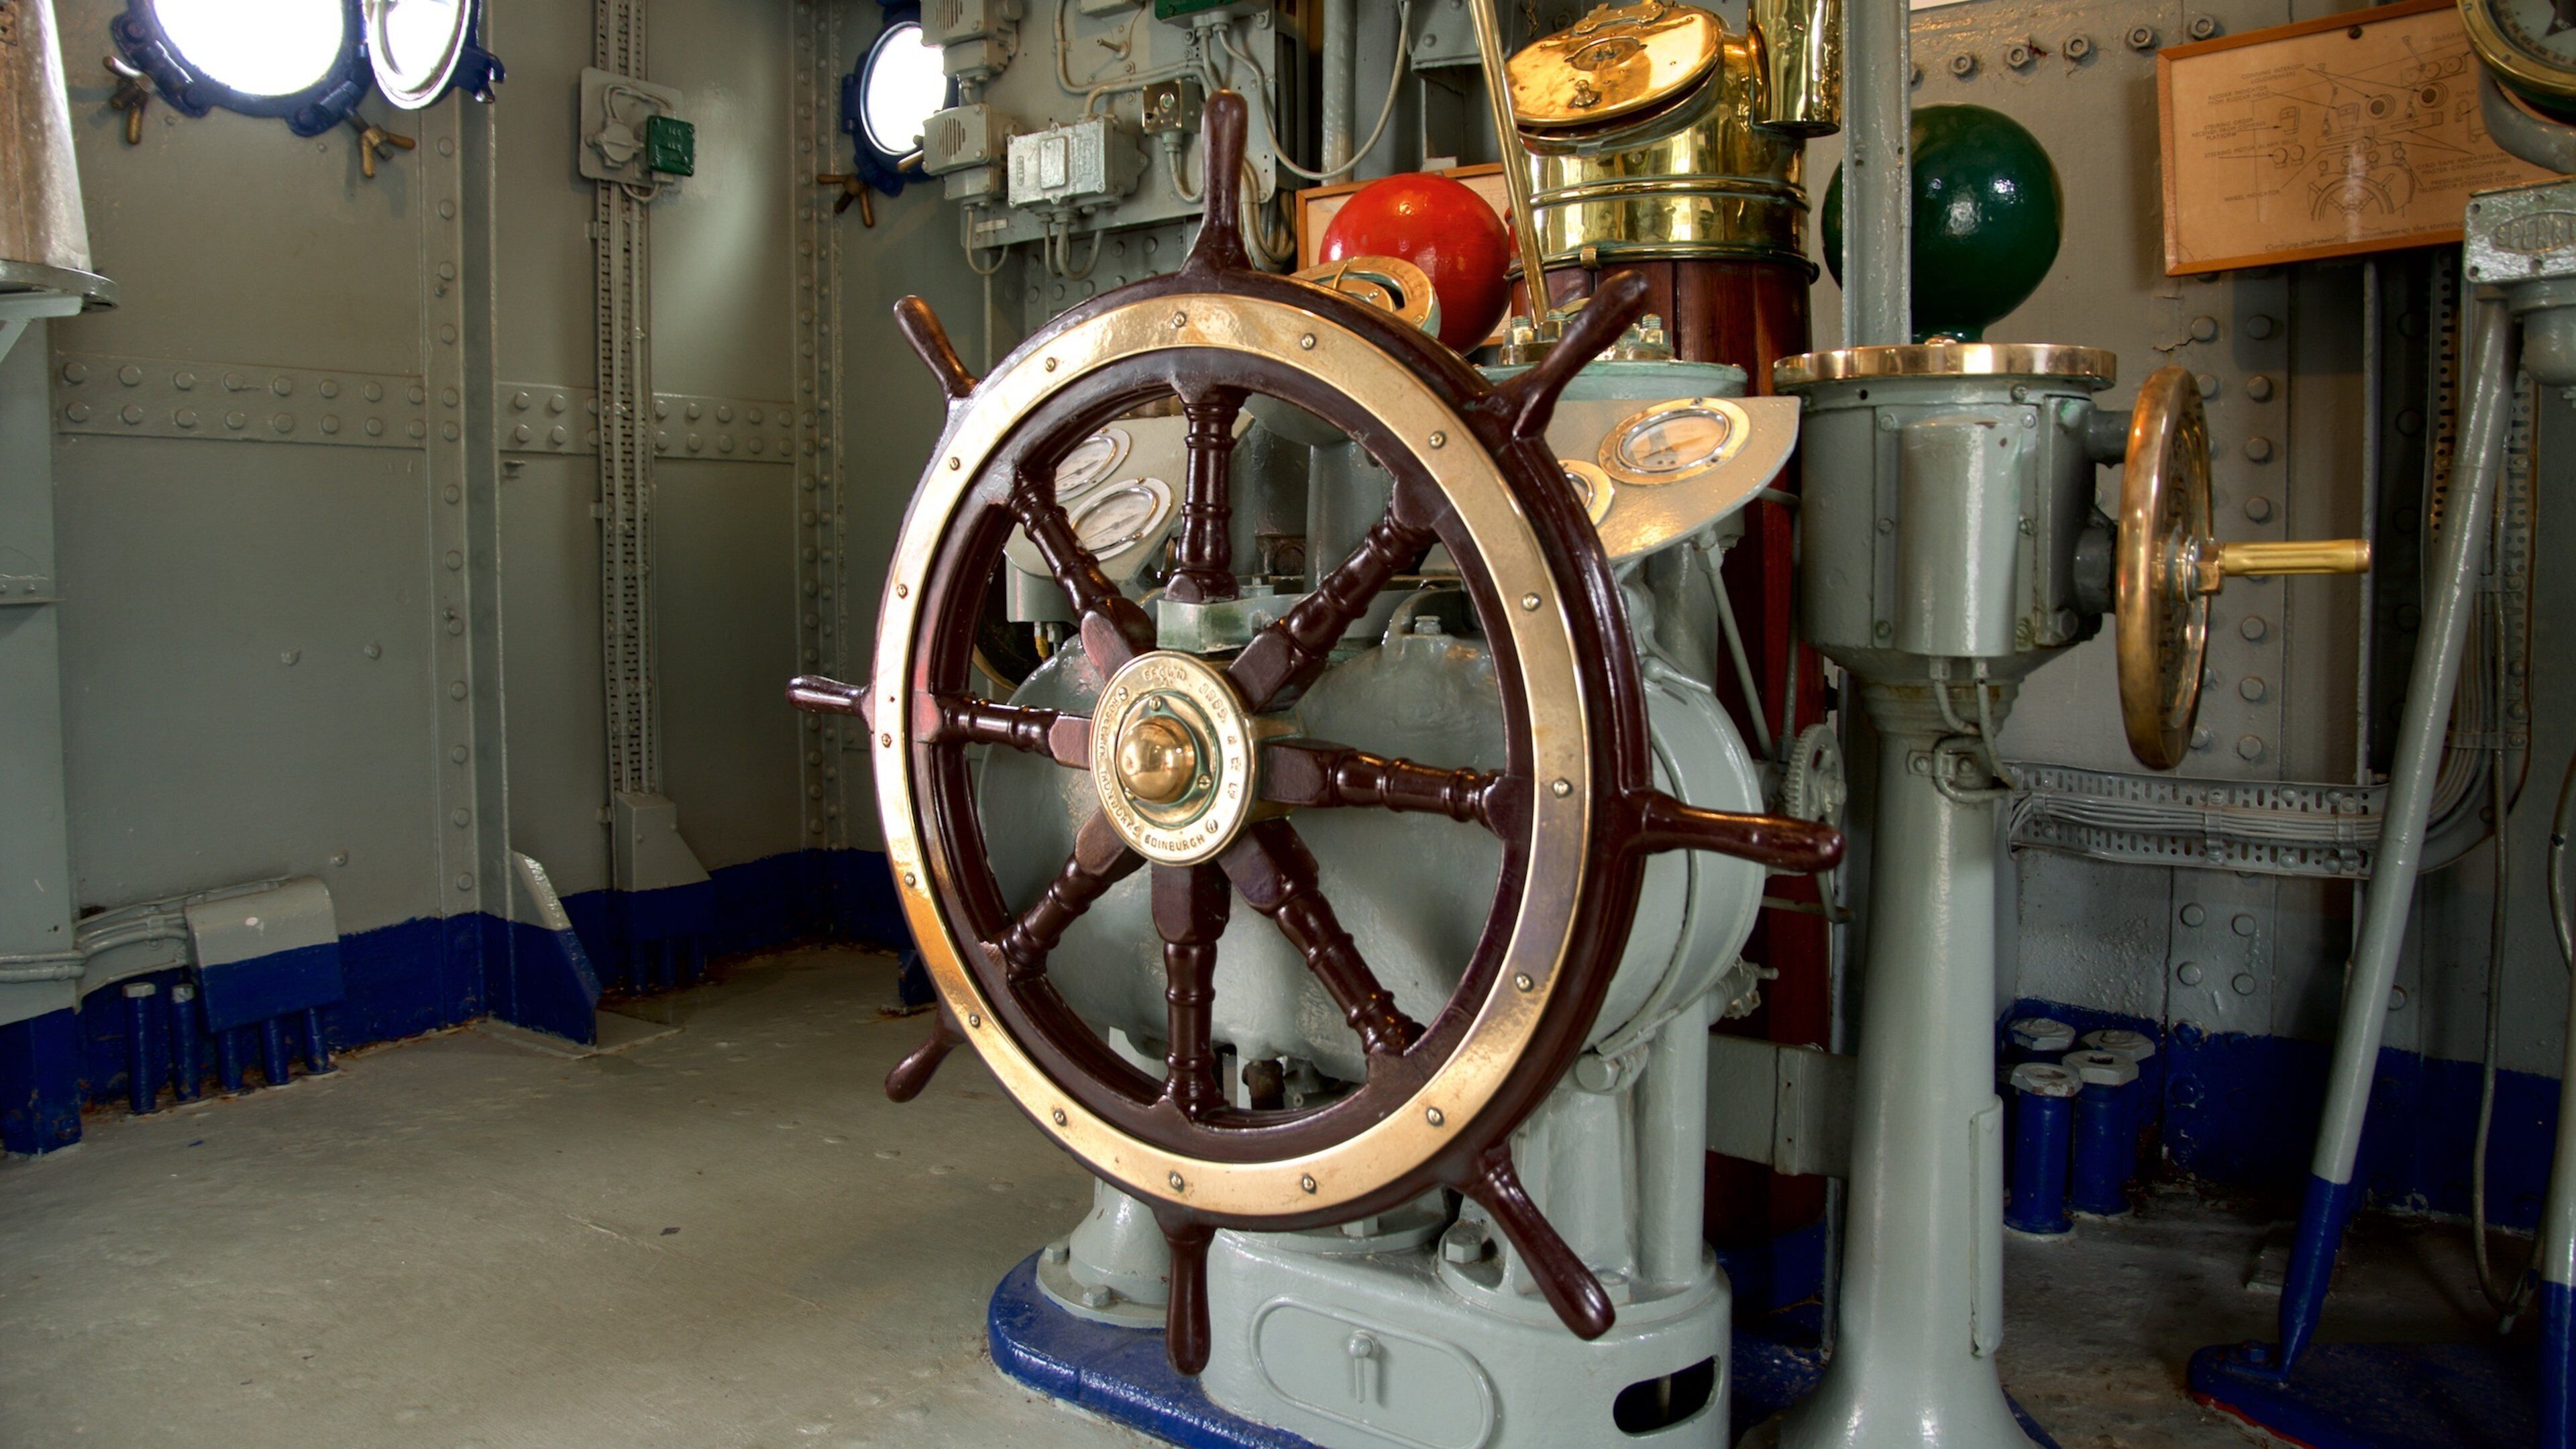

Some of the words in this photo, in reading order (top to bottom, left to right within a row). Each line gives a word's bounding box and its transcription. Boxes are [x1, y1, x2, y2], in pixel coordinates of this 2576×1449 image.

[2413, 224, 2426, 232] the
[2430, 221, 2463, 231] steering
[1143, 669, 1186, 680] BROWN
[1099, 769, 1141, 838] IRONWORKS
[1144, 833, 1205, 853] EDINBURGH
